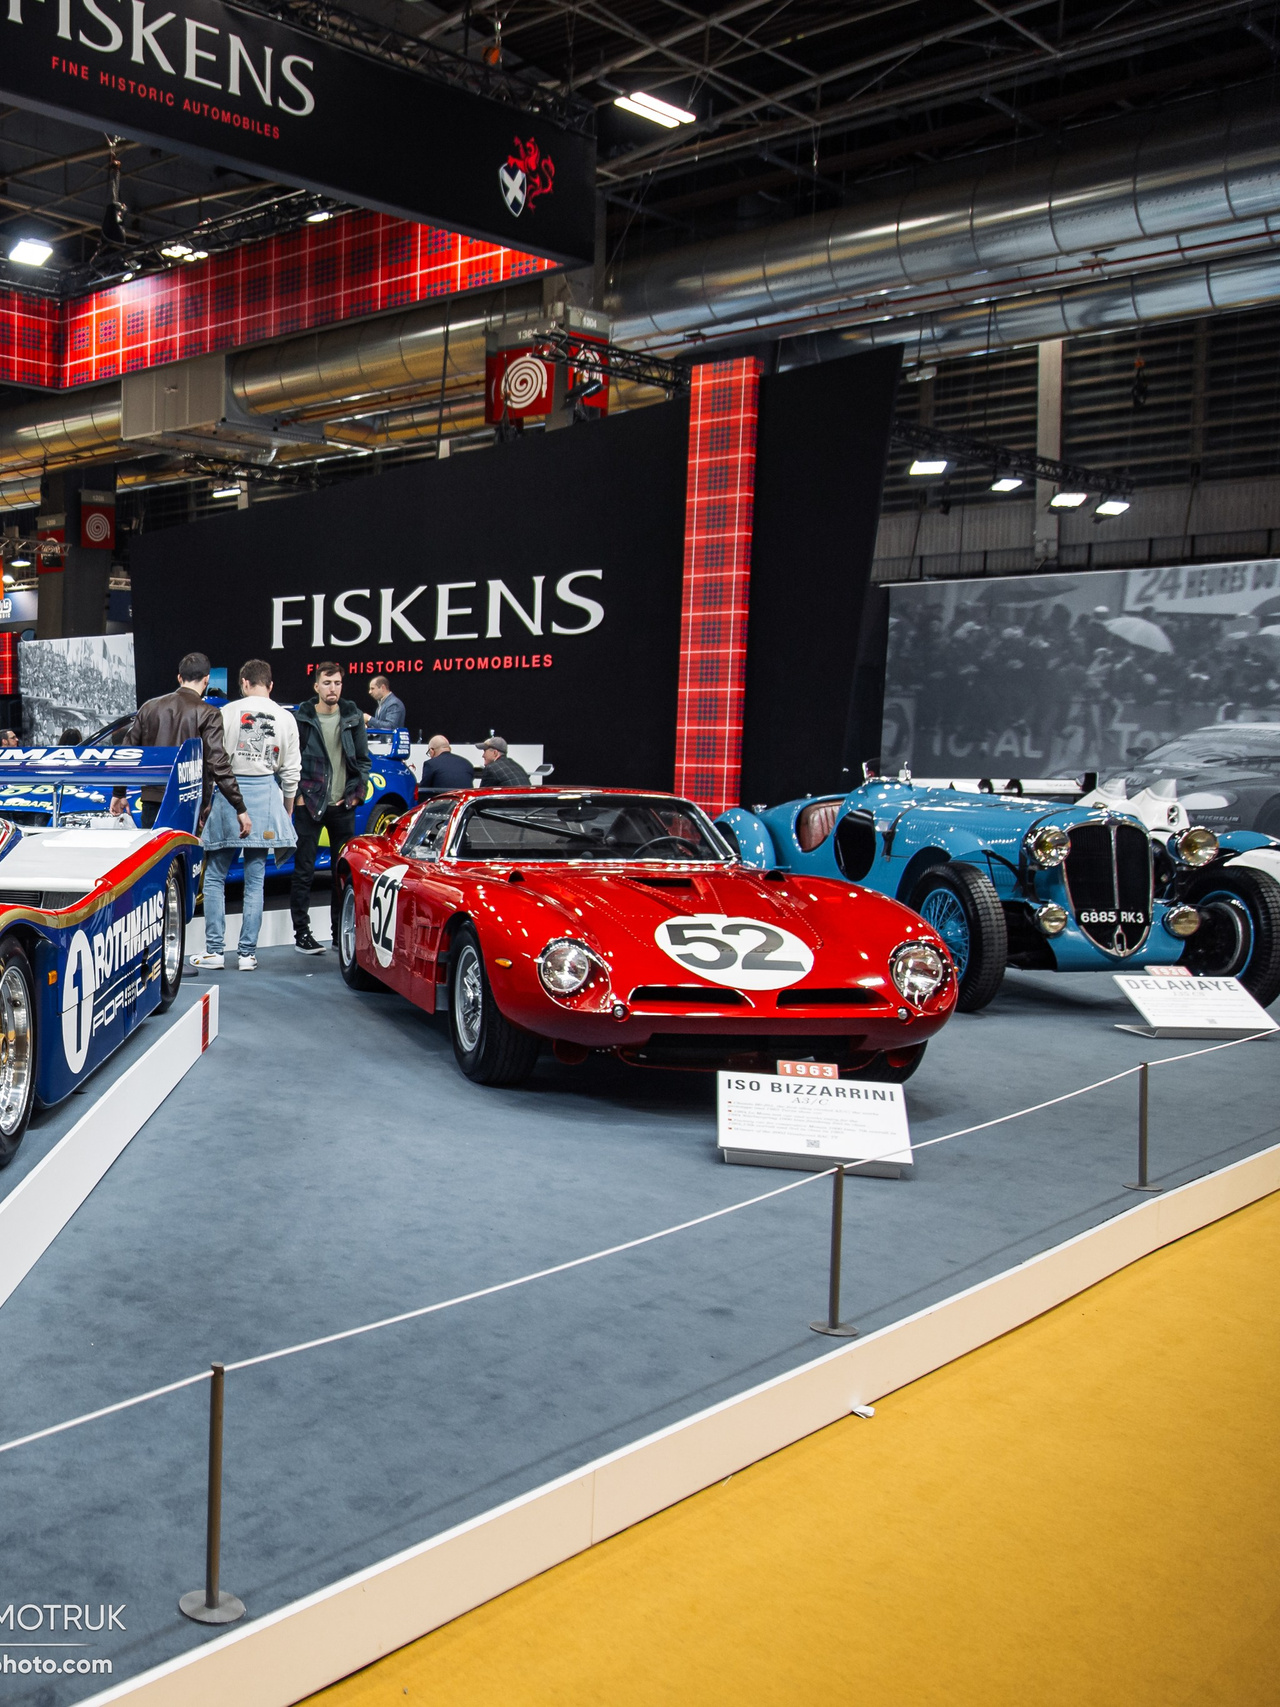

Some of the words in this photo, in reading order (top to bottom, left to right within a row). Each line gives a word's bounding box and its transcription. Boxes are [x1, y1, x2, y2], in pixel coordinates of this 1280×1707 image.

[51, 56, 89, 80] FINE
[100, 72, 174, 106] HISTORIC
[183, 99, 280, 139] AUTOMOBILES
[1133, 569, 1181, 604] 24
[271, 569, 605, 650] FISKENS
[349, 660, 424, 674] HISTORIC
[433, 654, 553, 671] AUTOMOBILES
[1197, 814, 1239, 822] MICHELIN
[370, 873, 398, 941] 52
[1081, 911, 1117, 923] 6885
[93, 890, 164, 990] ROTHMANS
[664, 923, 806, 971] 52
[1125, 979, 1239, 992] DELAHAYE
[72, 947, 85, 1054] 1
[783, 1063, 833, 1077] 1963
[727, 1078, 761, 1091] ISO
[770, 1081, 895, 1102] BIZZARRINI
[792, 1096, 830, 1106] A3/C
